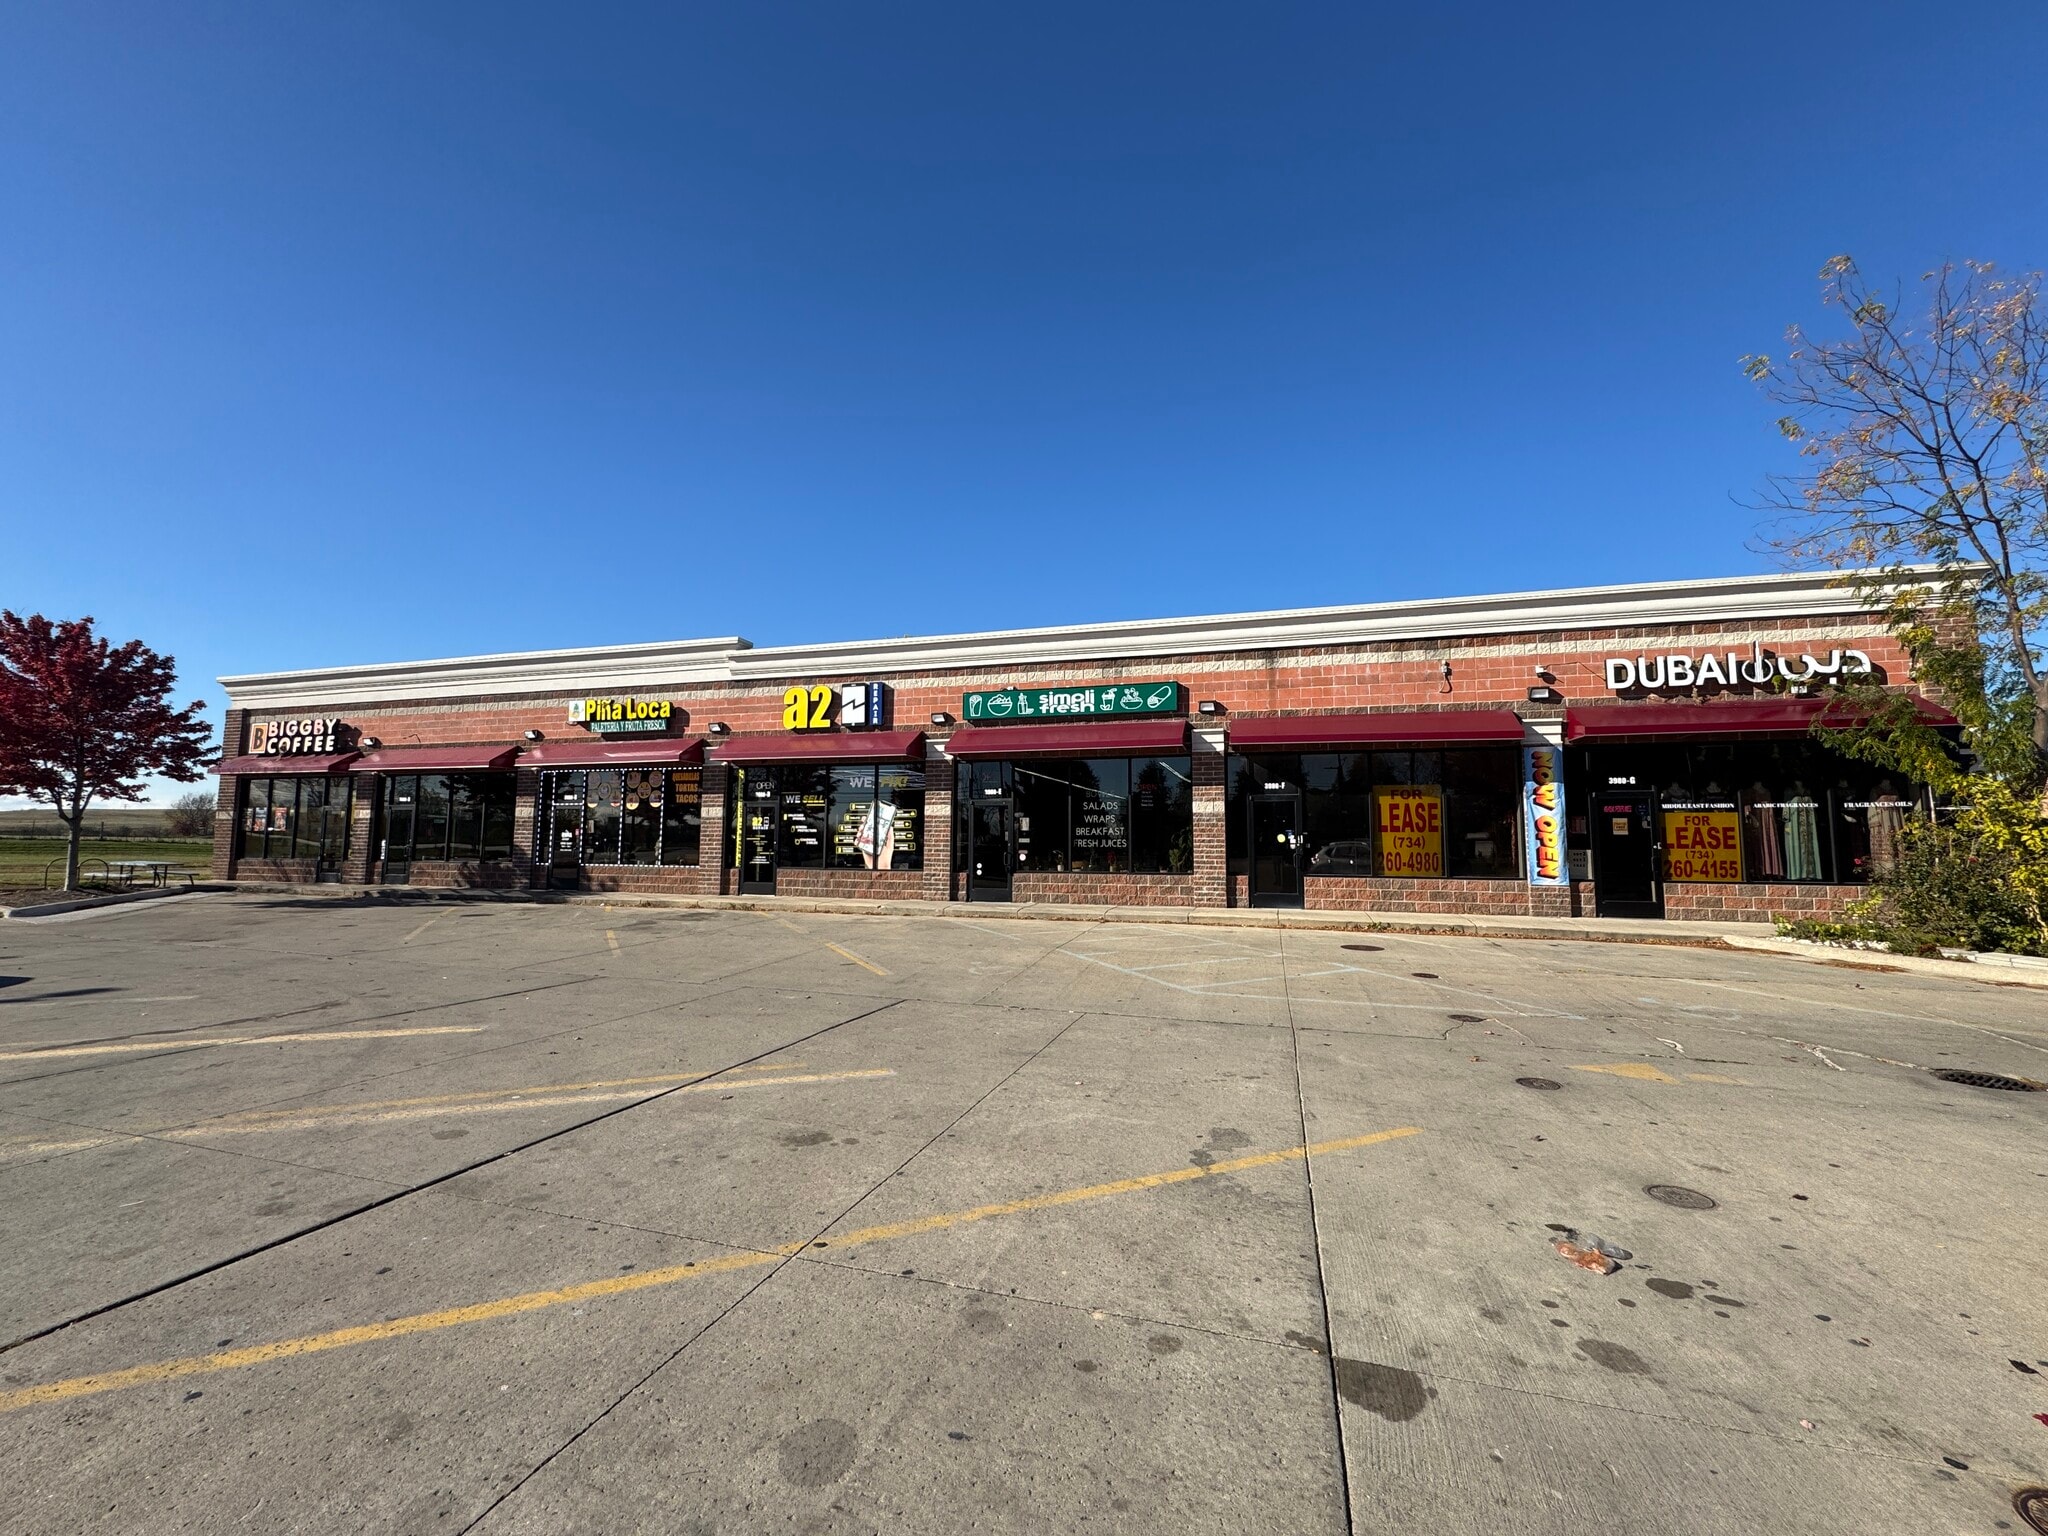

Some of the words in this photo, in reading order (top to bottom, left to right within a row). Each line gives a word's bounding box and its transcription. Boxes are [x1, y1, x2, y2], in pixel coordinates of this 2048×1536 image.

[1604, 653, 1737, 690] DUBAI
[873, 683, 881, 725] REPAIR
[1039, 689, 1095, 708] simpli
[585, 698, 622, 721] Piña
[627, 698, 671, 719] Loca
[783, 684, 833, 730] a2
[1040, 702, 1095, 714] fresh
[268, 719, 337, 737] BIGGBY
[625, 720, 643, 731] FRUTA
[644, 719, 667, 730] FRESCA
[267, 736, 335, 753] COFFEE
[676, 783, 699, 792] TORTAS
[756, 782, 775, 790] OPEN
[1532, 751, 1556, 811] NOW
[676, 794, 699, 803] TACOS
[786, 795, 801, 803] WE
[803, 795, 825, 803] SELL
[1391, 789, 1423, 800] FOR
[1083, 801, 1119, 810] SALADS
[1084, 815, 1116, 823] WRAPS
[1378, 802, 1439, 833] LEASE
[1683, 815, 1711, 826] FOR
[1075, 827, 1125, 836] BREAKFAST
[1662, 826, 1737, 849] LEASE
[1074, 839, 1099, 848] FRESH
[1100, 839, 1128, 848] JUICES
[1393, 836, 1426, 850] (734)
[1535, 815, 1560, 879] OPEN
[1685, 850, 1715, 859] (734)
[1663, 860, 1739, 878] 260-4155
